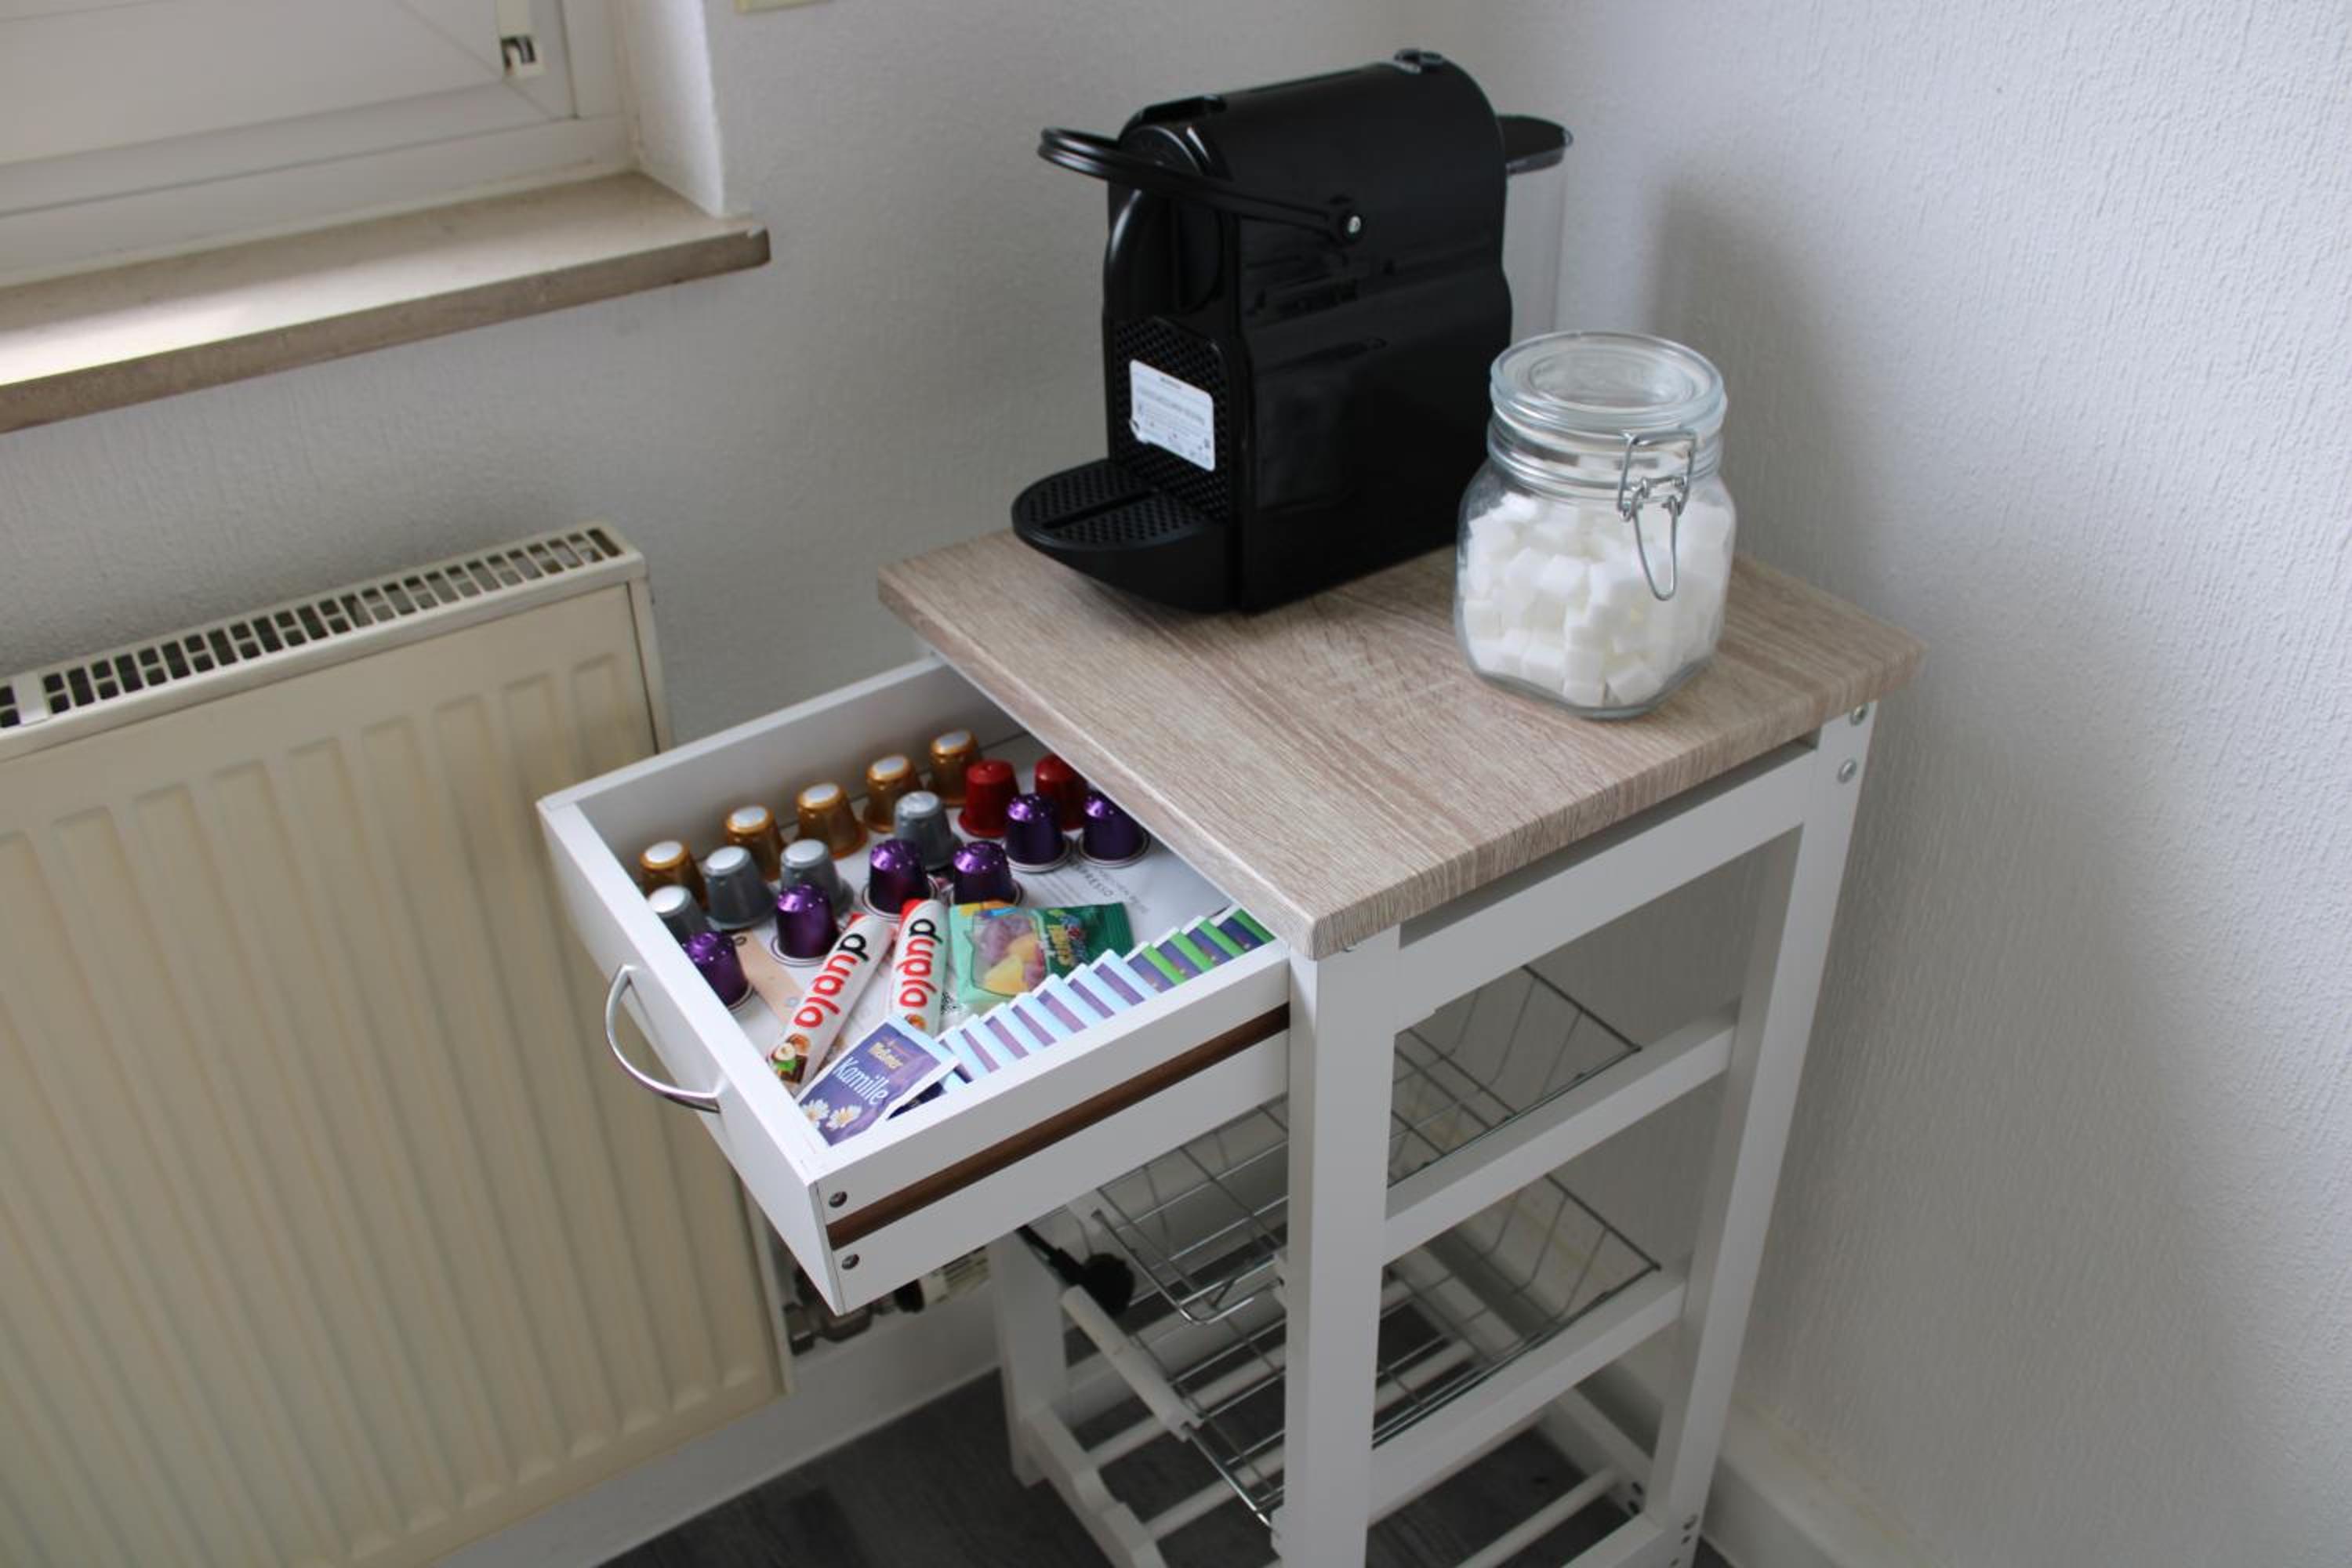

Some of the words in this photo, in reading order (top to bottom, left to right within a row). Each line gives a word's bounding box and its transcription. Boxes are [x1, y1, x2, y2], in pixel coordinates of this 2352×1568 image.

[795, 934, 869, 1028] duplo
[898, 919, 942, 1007] duplo
[833, 1057, 889, 1105] Kamille
